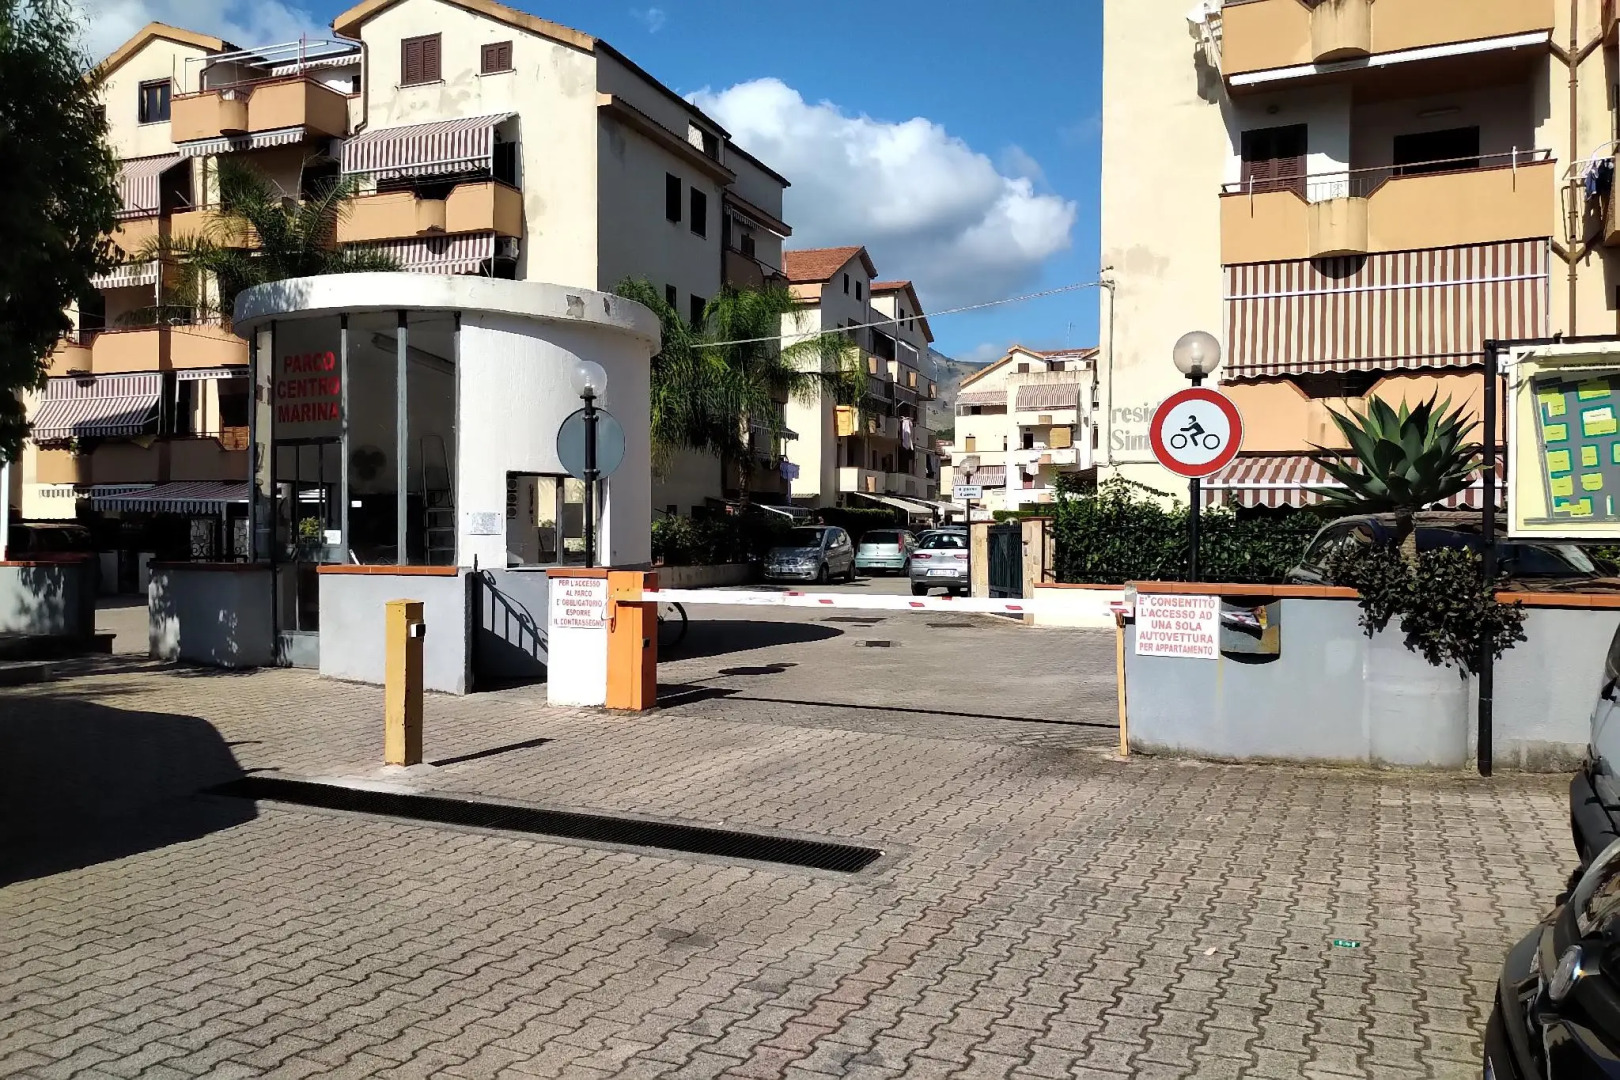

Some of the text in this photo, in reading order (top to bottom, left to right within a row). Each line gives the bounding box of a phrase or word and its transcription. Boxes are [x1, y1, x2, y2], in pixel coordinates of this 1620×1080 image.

[284, 351, 335, 374] PARCO
[277, 376, 340, 399] CENTRO
[278, 402, 339, 423] MARINA
[1111, 429, 1150, 451] Sim
[562, 599, 603, 607] OBBLIGATORIO
[1151, 597, 1215, 609] CONSENTITO
[566, 609, 591, 617] ESPORRE
[1141, 608, 1213, 620] L'ACCESSO AD
[560, 618, 605, 627] CONTRASSEGNO
[1151, 620, 1202, 631] UNA SOLA
[1140, 631, 1213, 643] AUTOVETTURA
[1140, 642, 1213, 656] PER APPARTAMENTO
